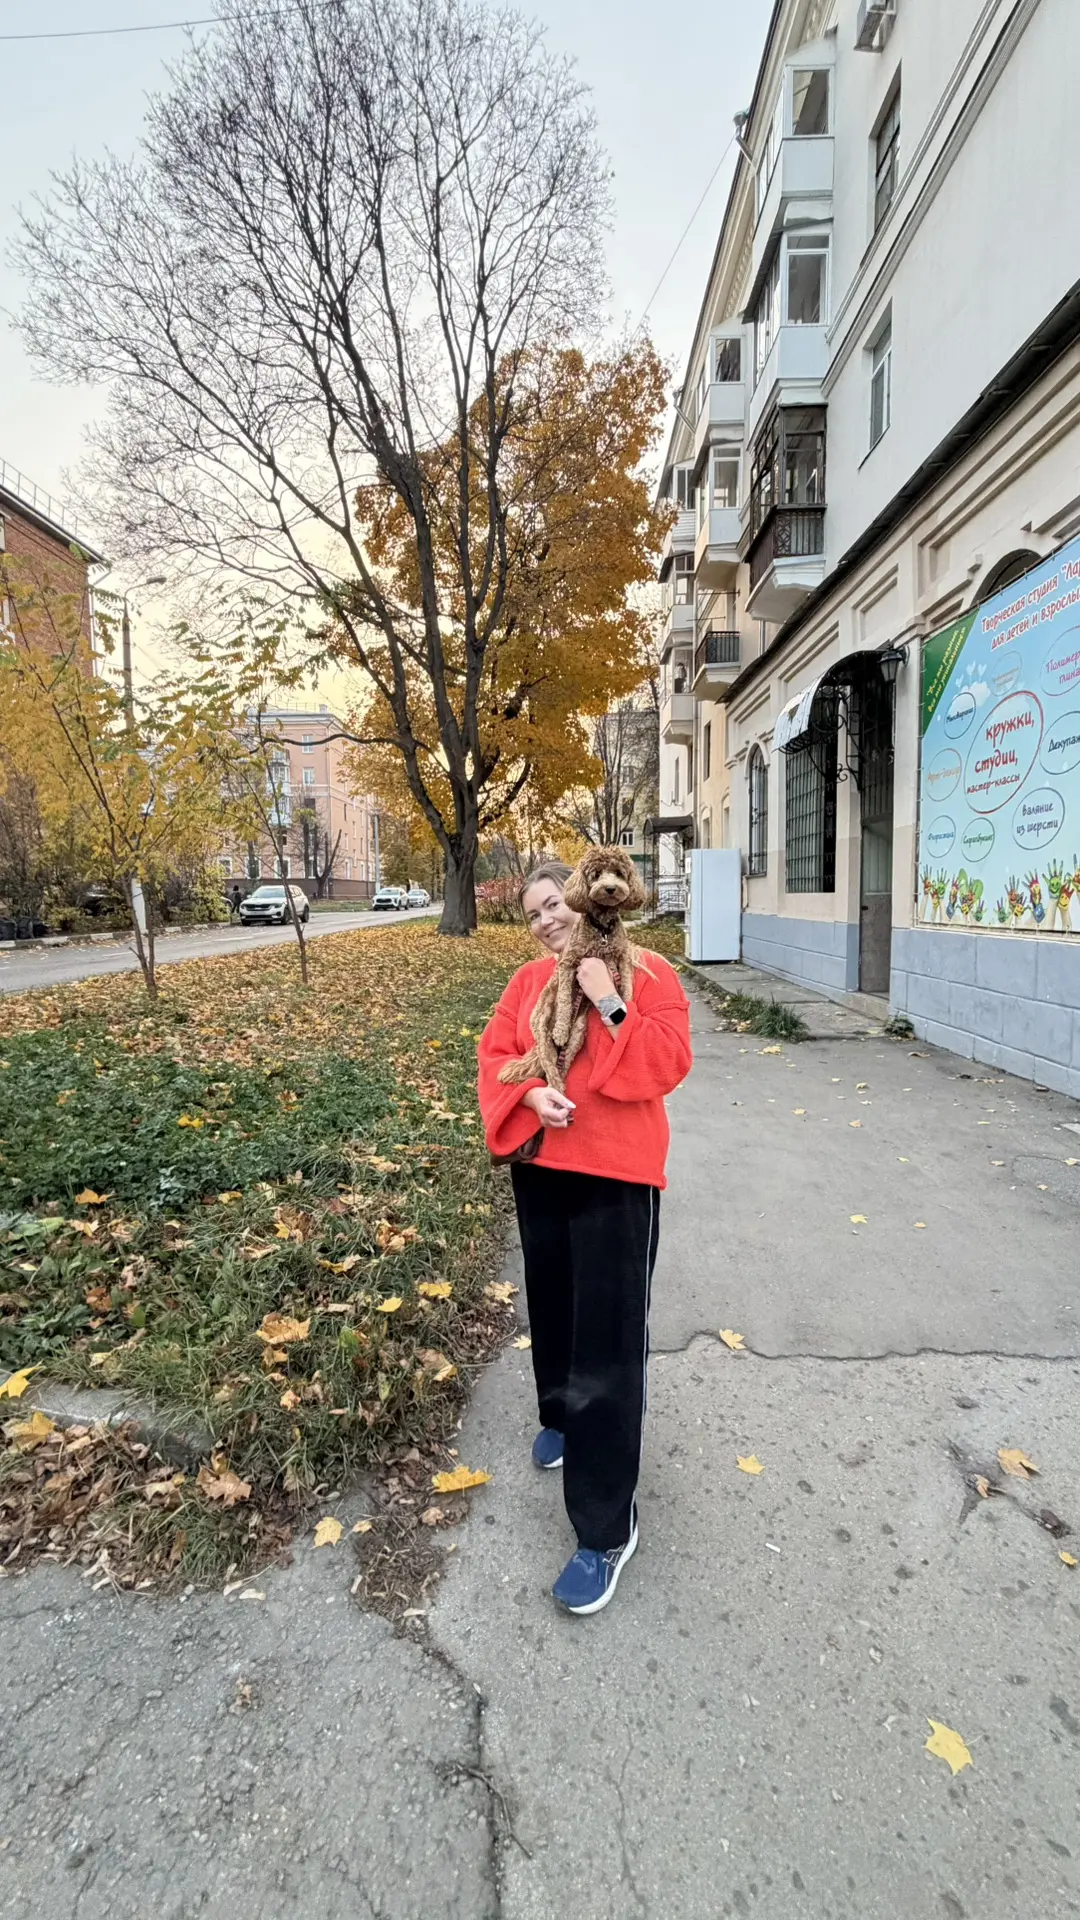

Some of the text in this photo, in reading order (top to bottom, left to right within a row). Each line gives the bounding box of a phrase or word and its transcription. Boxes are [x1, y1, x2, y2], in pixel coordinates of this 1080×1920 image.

[982, 595, 1026, 632] Творческая
[1028, 575, 1058, 603] студия
[991, 631, 1005, 650] для
[1006, 616, 1029, 643] детей
[1032, 612, 1038, 626] и
[986, 711, 1034, 748] кружки,
[975, 749, 1018, 778] студии,
[967, 773, 1021, 795] мастер-классы
[1022, 802, 1054, 817] валяние
[1016, 819, 1059, 838] из шерсти
